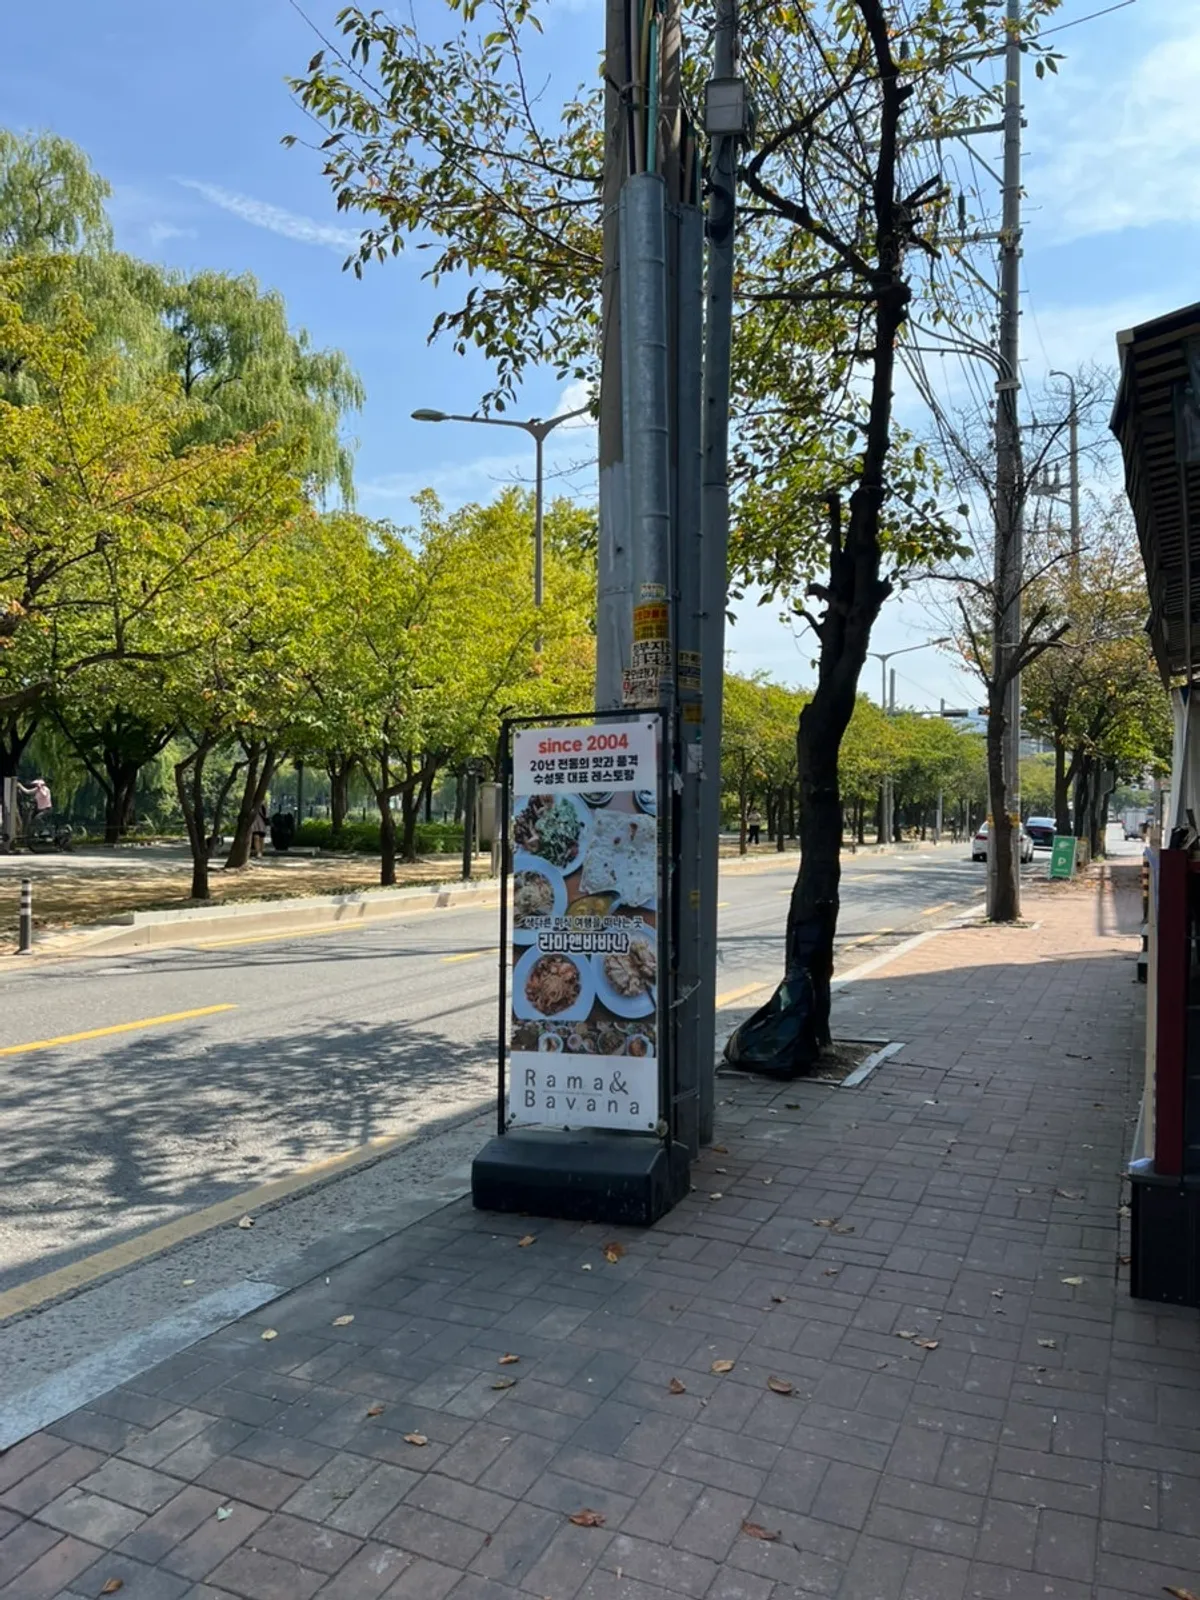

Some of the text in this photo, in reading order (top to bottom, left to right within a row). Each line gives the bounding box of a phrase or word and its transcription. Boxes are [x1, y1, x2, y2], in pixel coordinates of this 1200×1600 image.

[538, 733, 629, 754] since 2004
[530, 754, 639, 772] 20년 전통의 맛과 품격
[533, 769, 635, 785] 수성못 대표 레스토랑
[525, 916, 643, 929] 색다른 미식 여행을 떠나는 곳
[538, 932, 630, 953] 라마앤바바나
[525, 1090, 640, 1115] Bavana
